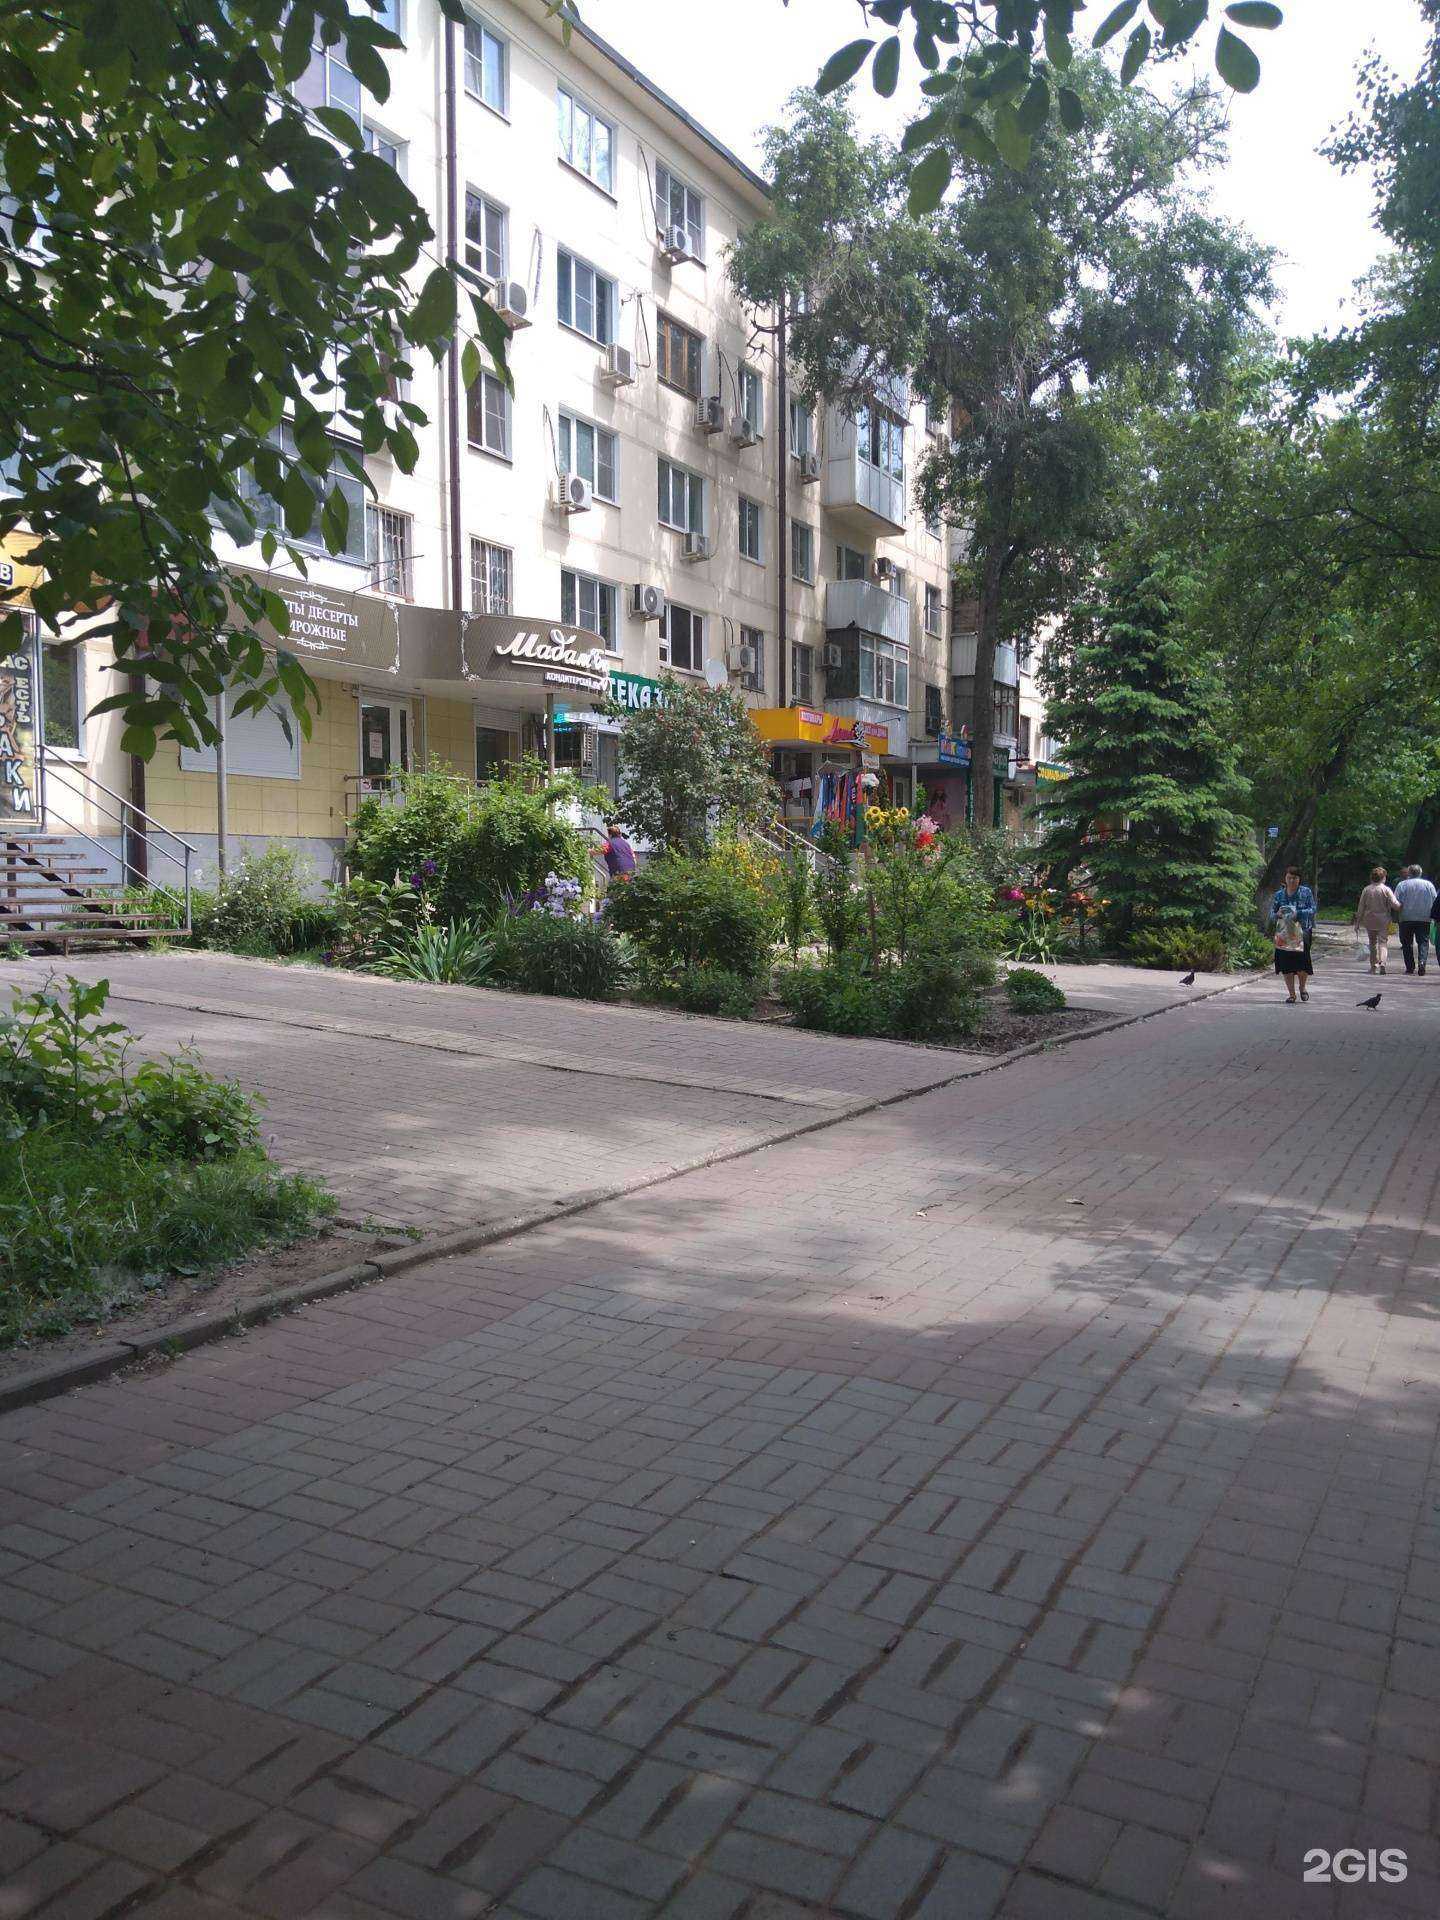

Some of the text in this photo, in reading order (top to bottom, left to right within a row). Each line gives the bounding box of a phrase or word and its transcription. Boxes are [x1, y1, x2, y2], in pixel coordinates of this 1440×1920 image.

[308, 605, 359, 627] ДЕСЕРТЫ
[289, 619, 347, 642] ИРОЖНЫЕ
[608, 677, 652, 710] ТЕКА
